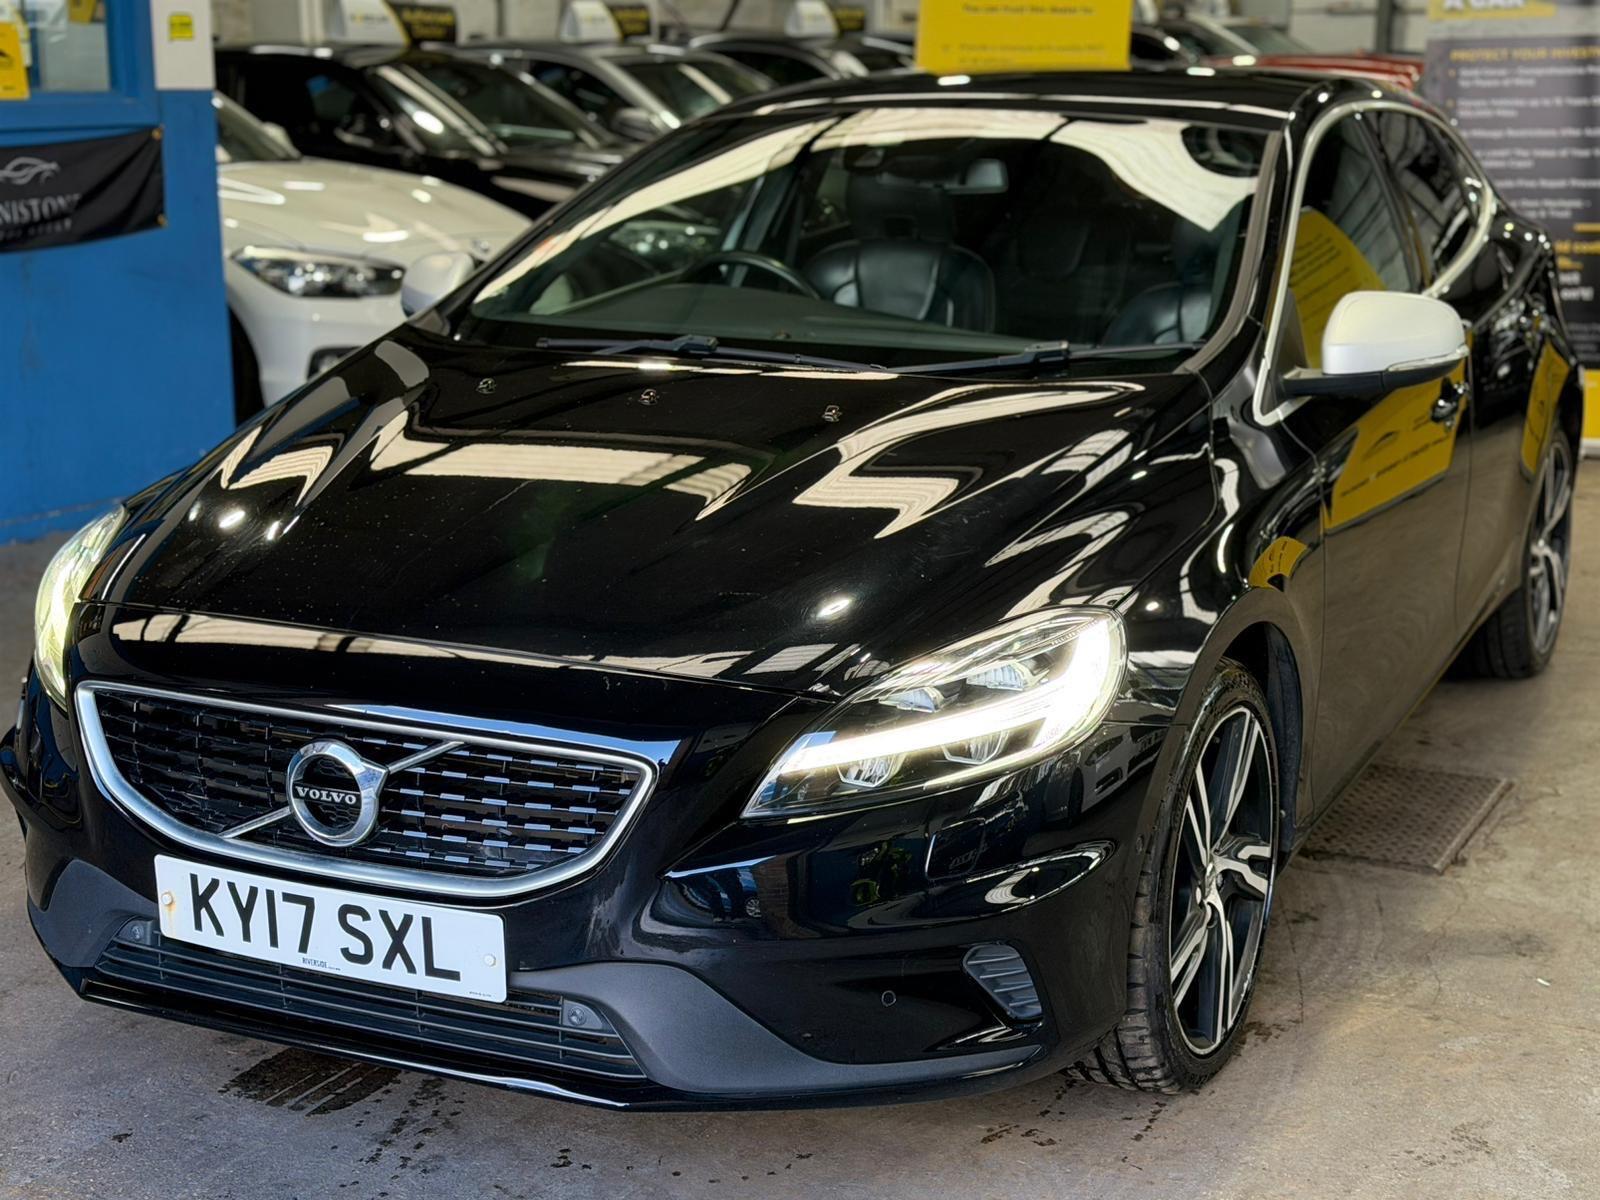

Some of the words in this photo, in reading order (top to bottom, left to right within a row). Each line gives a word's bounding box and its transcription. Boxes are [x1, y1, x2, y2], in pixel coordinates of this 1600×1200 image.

[294, 785, 357, 805] VOLVO
[188, 873, 316, 955] KY17
[336, 902, 463, 983] SXL
